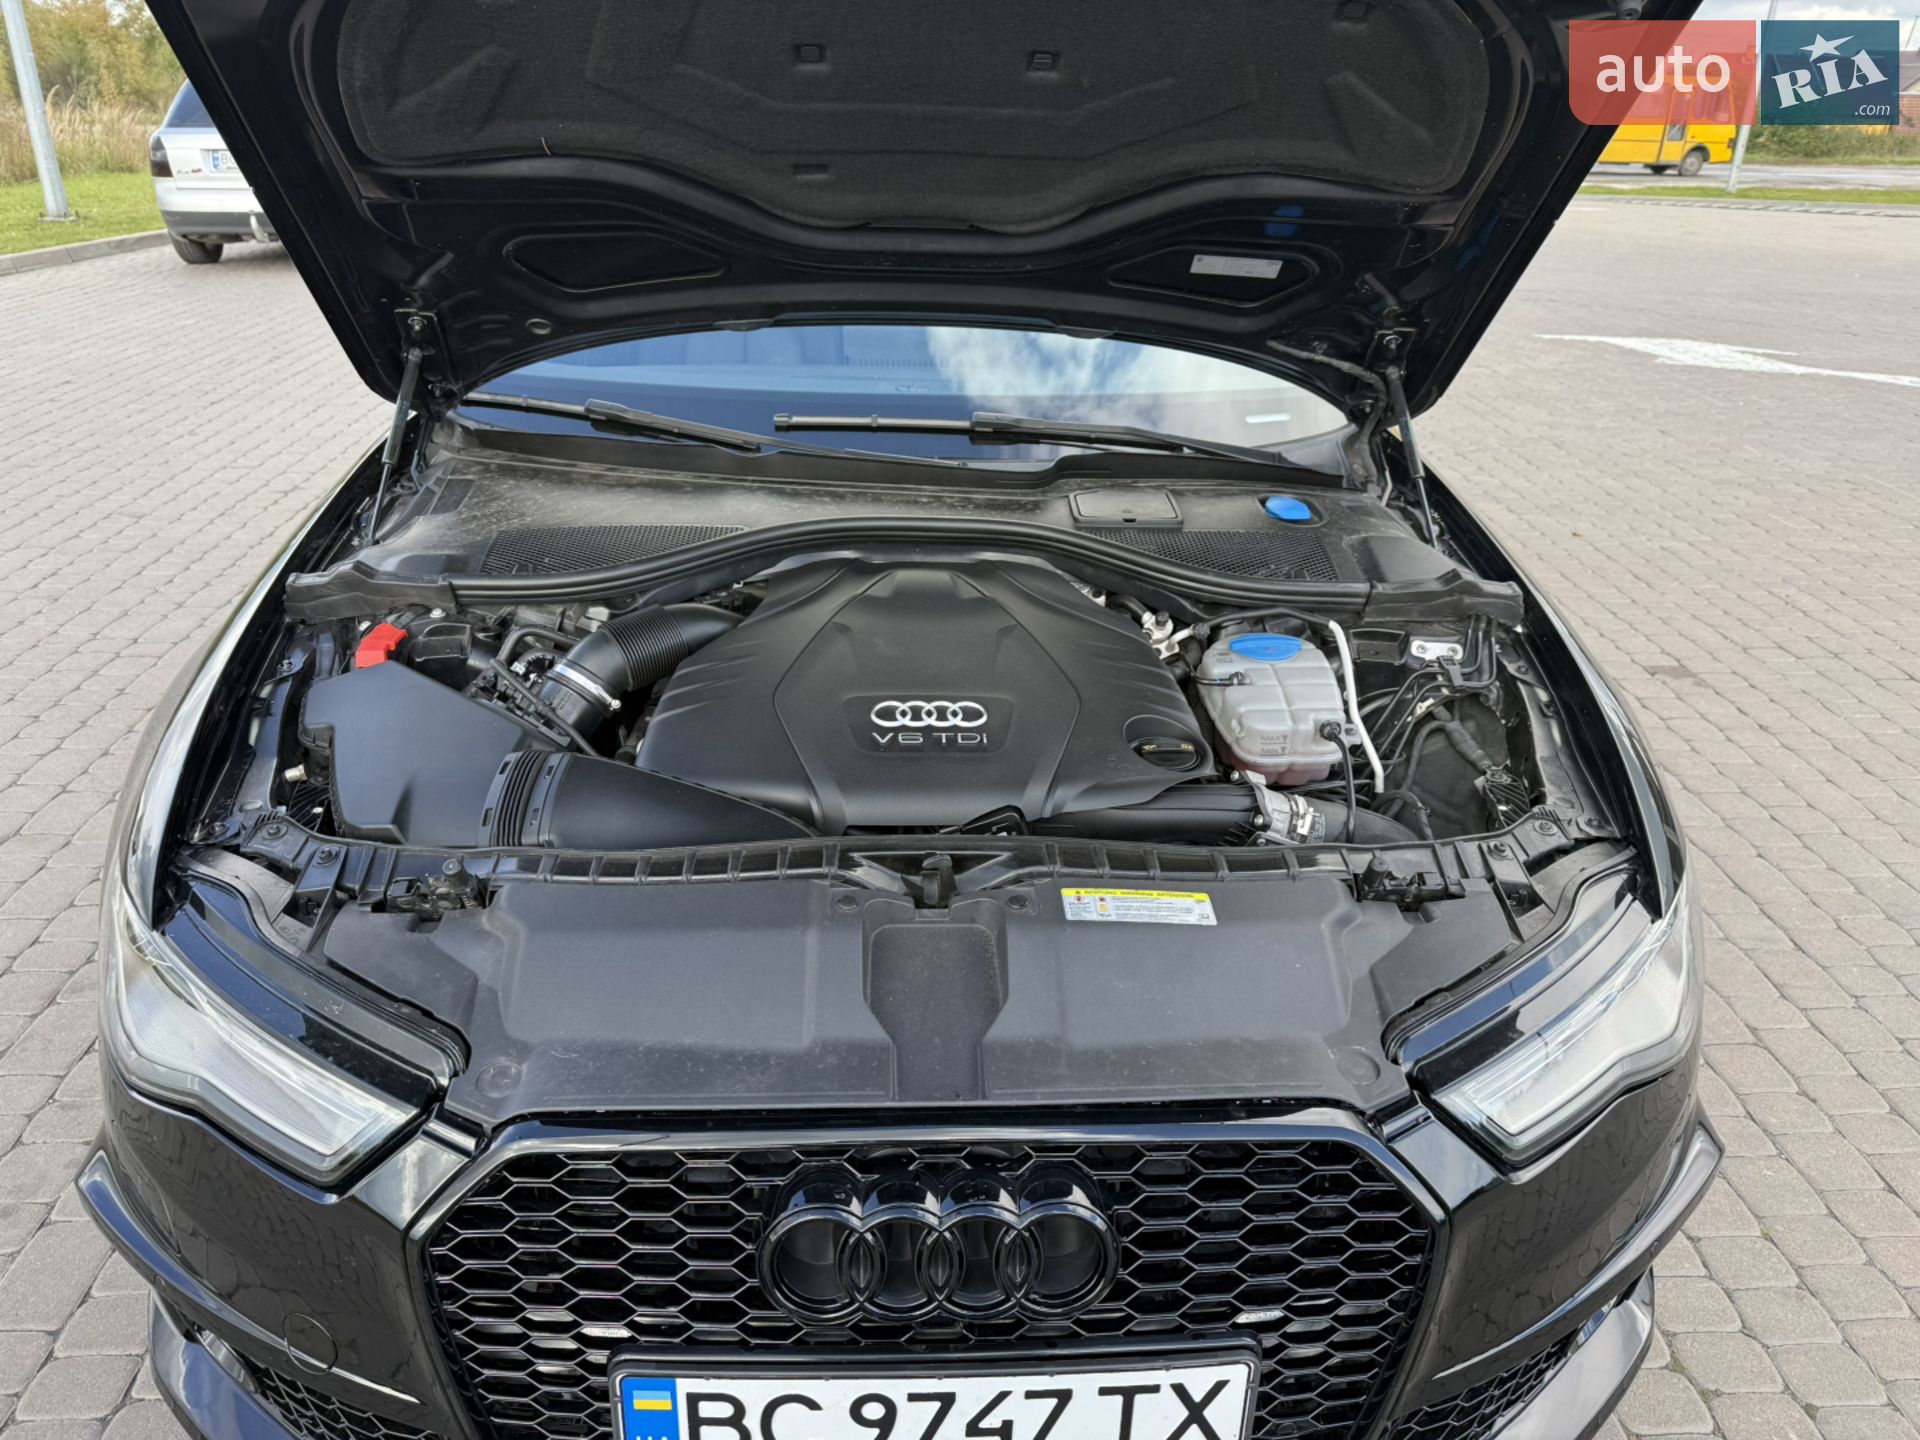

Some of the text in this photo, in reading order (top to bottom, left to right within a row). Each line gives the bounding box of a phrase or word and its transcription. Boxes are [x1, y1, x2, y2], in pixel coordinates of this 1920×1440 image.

[872, 732, 923, 744] V6
[685, 1379, 1231, 1440] BC 9747 TX
